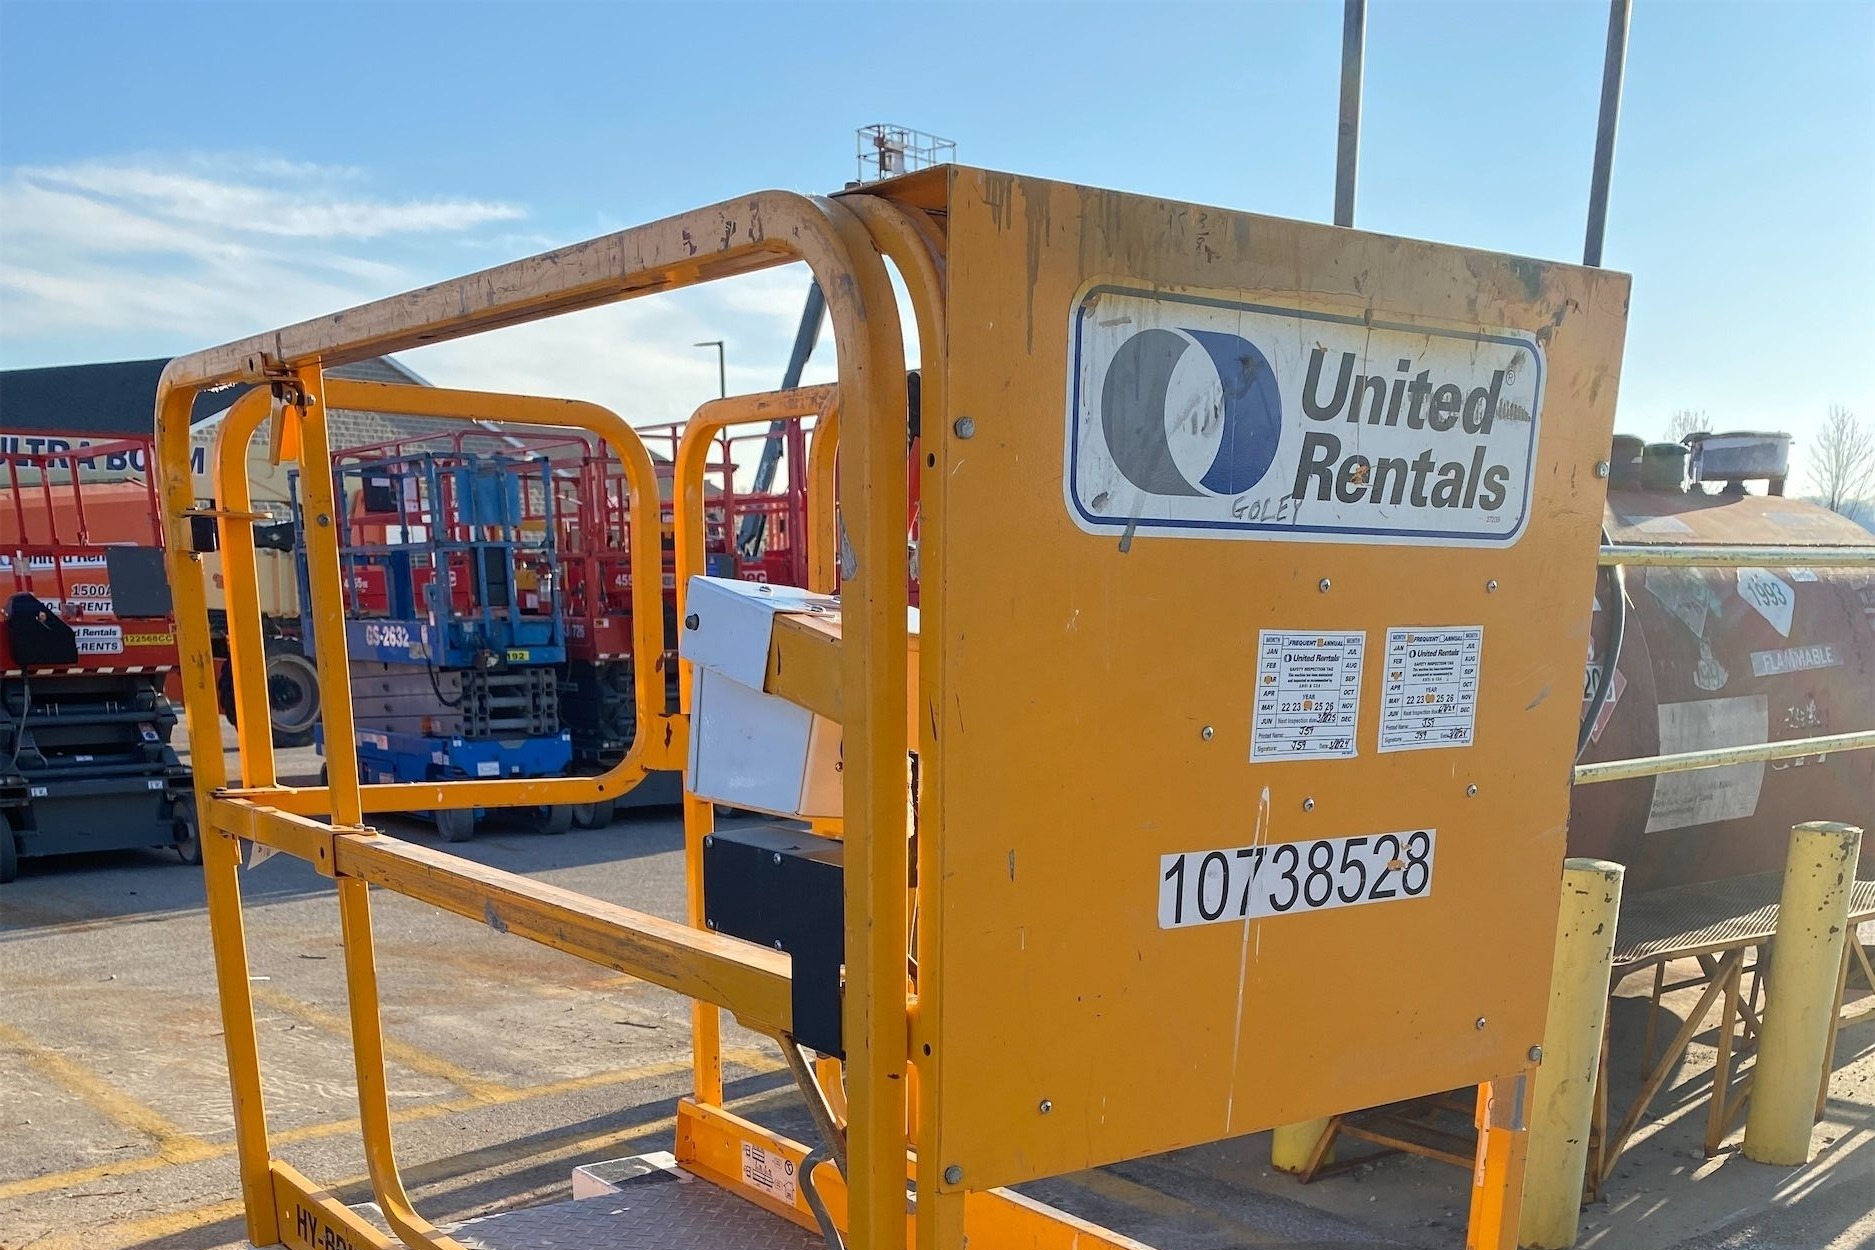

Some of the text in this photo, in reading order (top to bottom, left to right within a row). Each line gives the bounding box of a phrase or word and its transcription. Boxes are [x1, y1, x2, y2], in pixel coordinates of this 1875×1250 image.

[1301, 348, 1506, 434] United
[1292, 431, 1509, 511] Rentals
[1747, 581, 1787, 607] 1993
[82, 628, 117, 637] Rentals
[366, 624, 410, 648] GS-2632
[1288, 639, 1317, 647] FREQUENT
[1293, 653, 1340, 663] United Rentals
[1437, 648, 1460, 657] Rentals
[1406, 696, 1415, 705] 22
[1416, 695, 1425, 704] 23
[1436, 694, 1445, 703] 25
[1446, 694, 1454, 703] 26
[1281, 702, 1290, 712] 22
[1292, 702, 1301, 712] 23
[1314, 702, 1323, 711] 25
[1325, 702, 1334, 711] 26
[1164, 831, 1430, 924] 10738528
